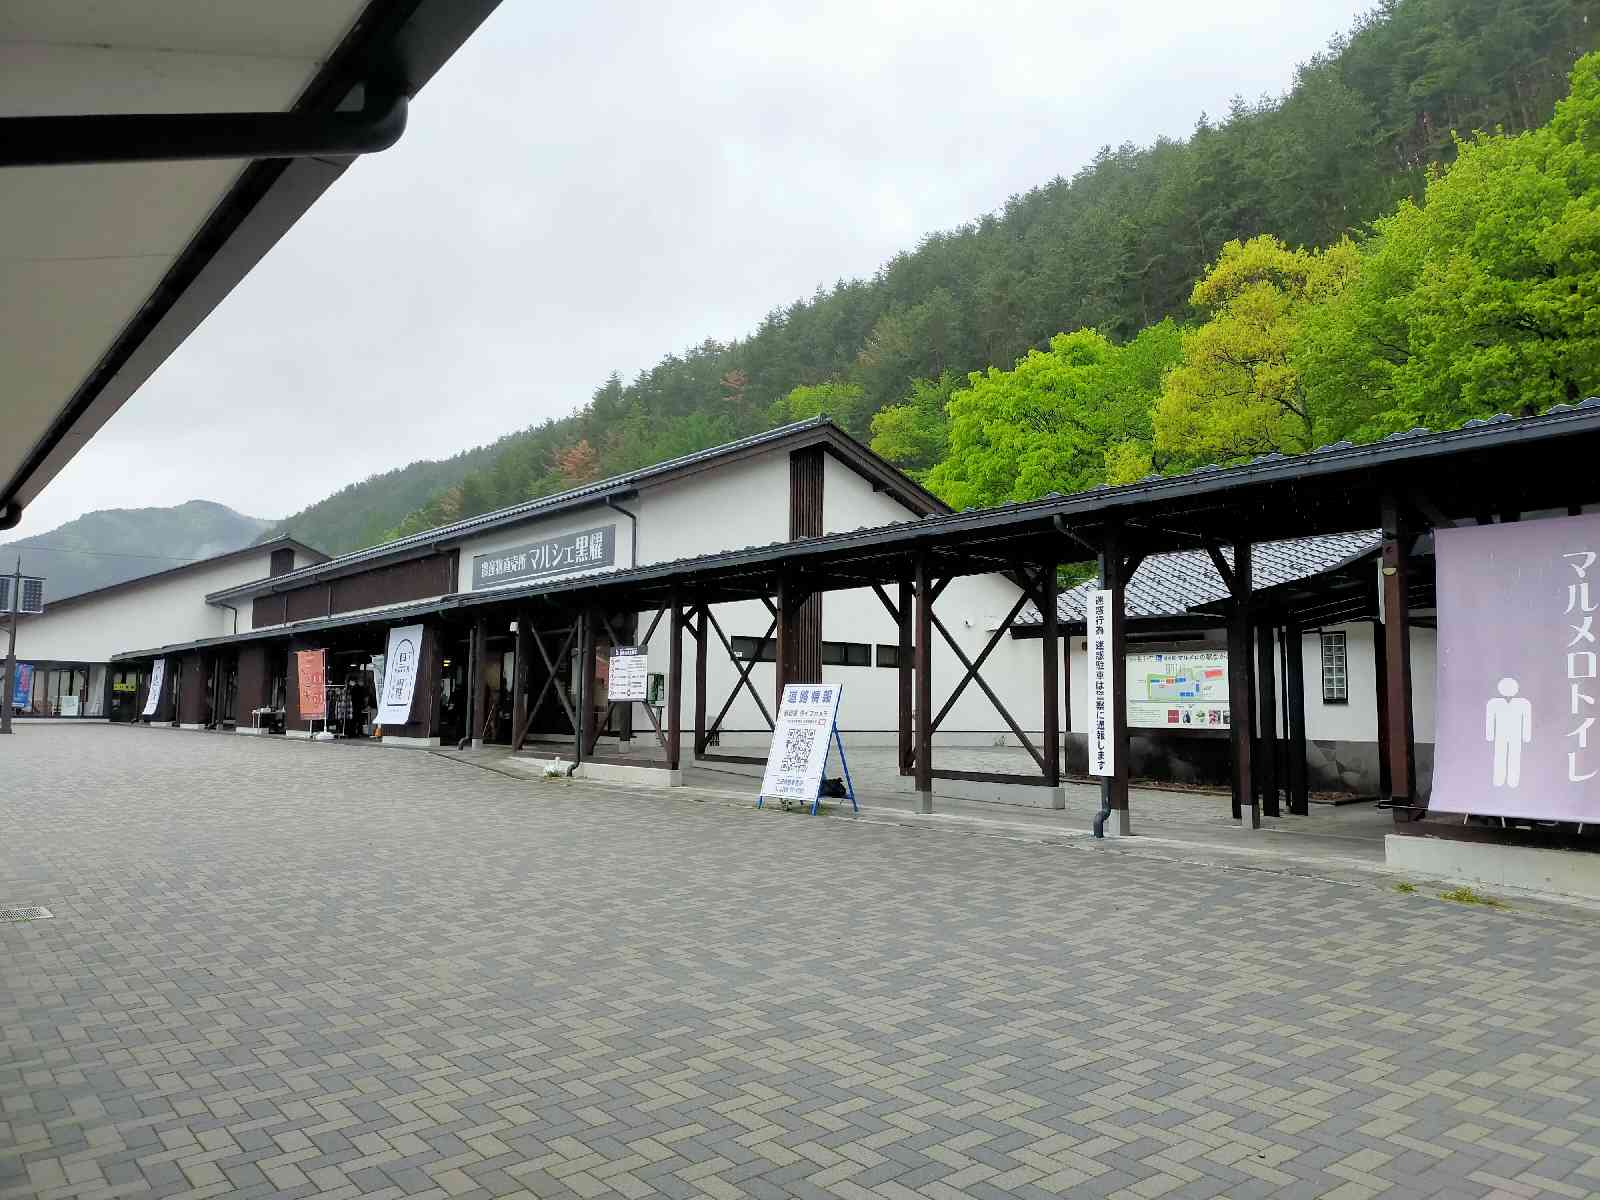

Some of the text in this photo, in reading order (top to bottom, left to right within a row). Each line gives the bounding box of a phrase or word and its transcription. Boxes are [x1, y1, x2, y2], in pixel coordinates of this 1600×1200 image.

[788, 690, 833, 704] 道路情報
[1562, 551, 1599, 782] マルメロトイレ
